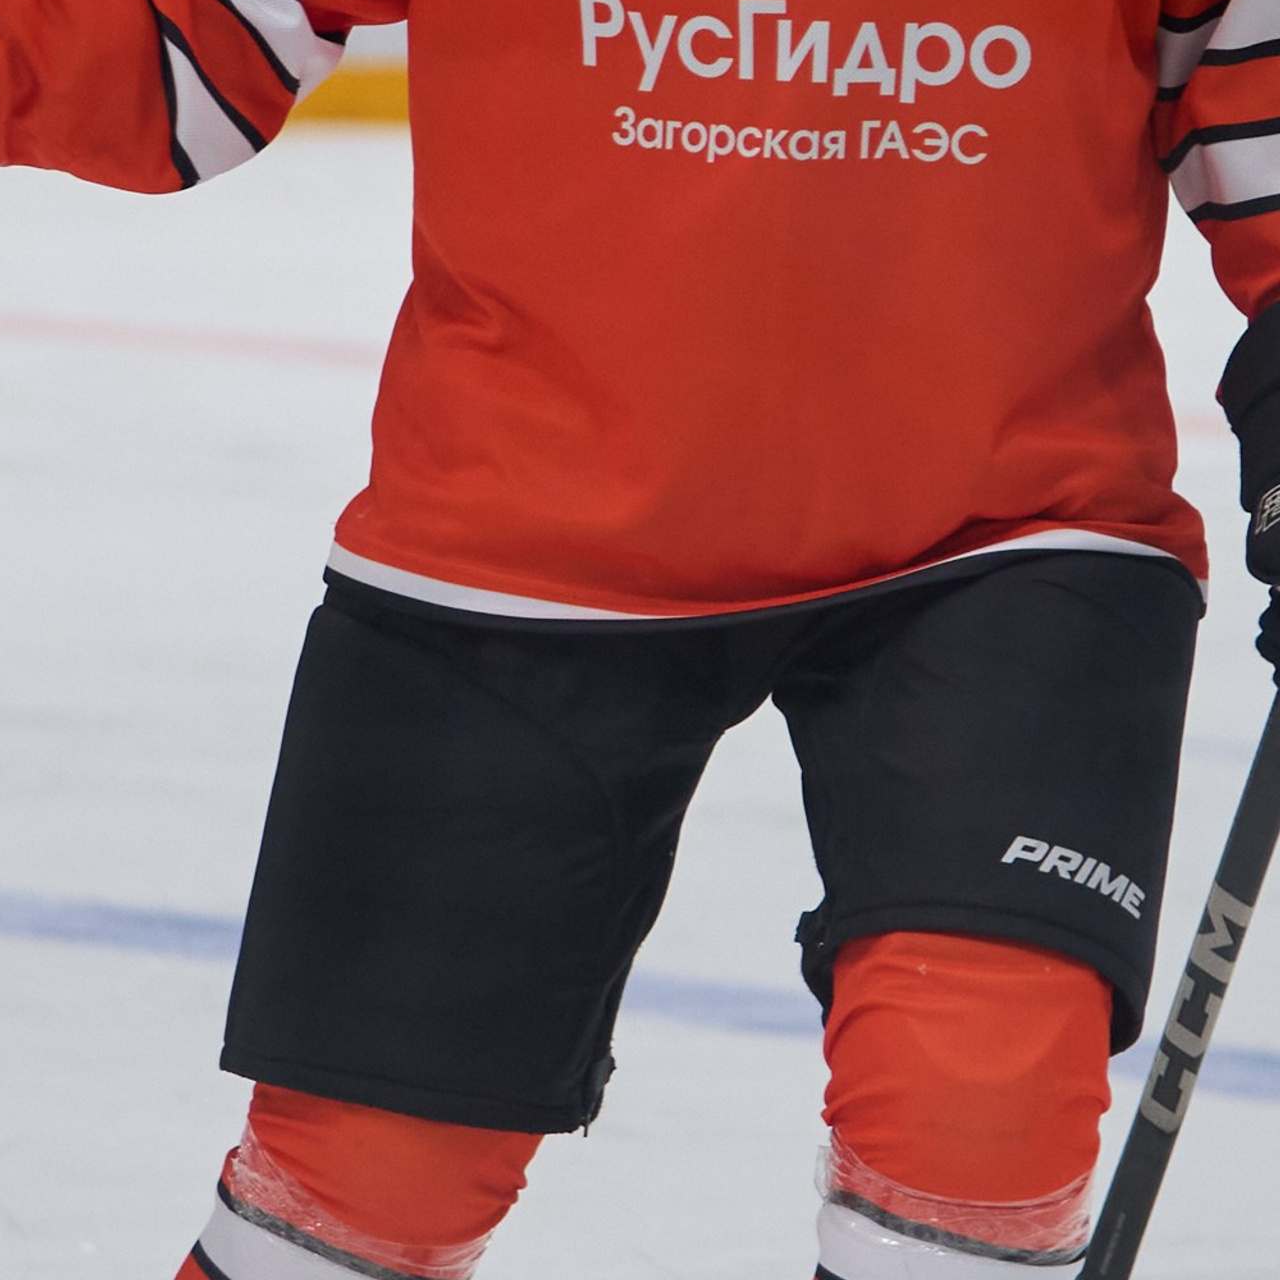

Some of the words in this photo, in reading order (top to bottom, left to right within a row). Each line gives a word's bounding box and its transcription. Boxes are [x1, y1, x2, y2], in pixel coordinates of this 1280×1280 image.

[611, 105, 847, 163] Загорская
[859, 119, 989, 166] ГАЭС
[1000, 835, 1147, 921] PRIME
[1139, 880, 1256, 1134] CCM
